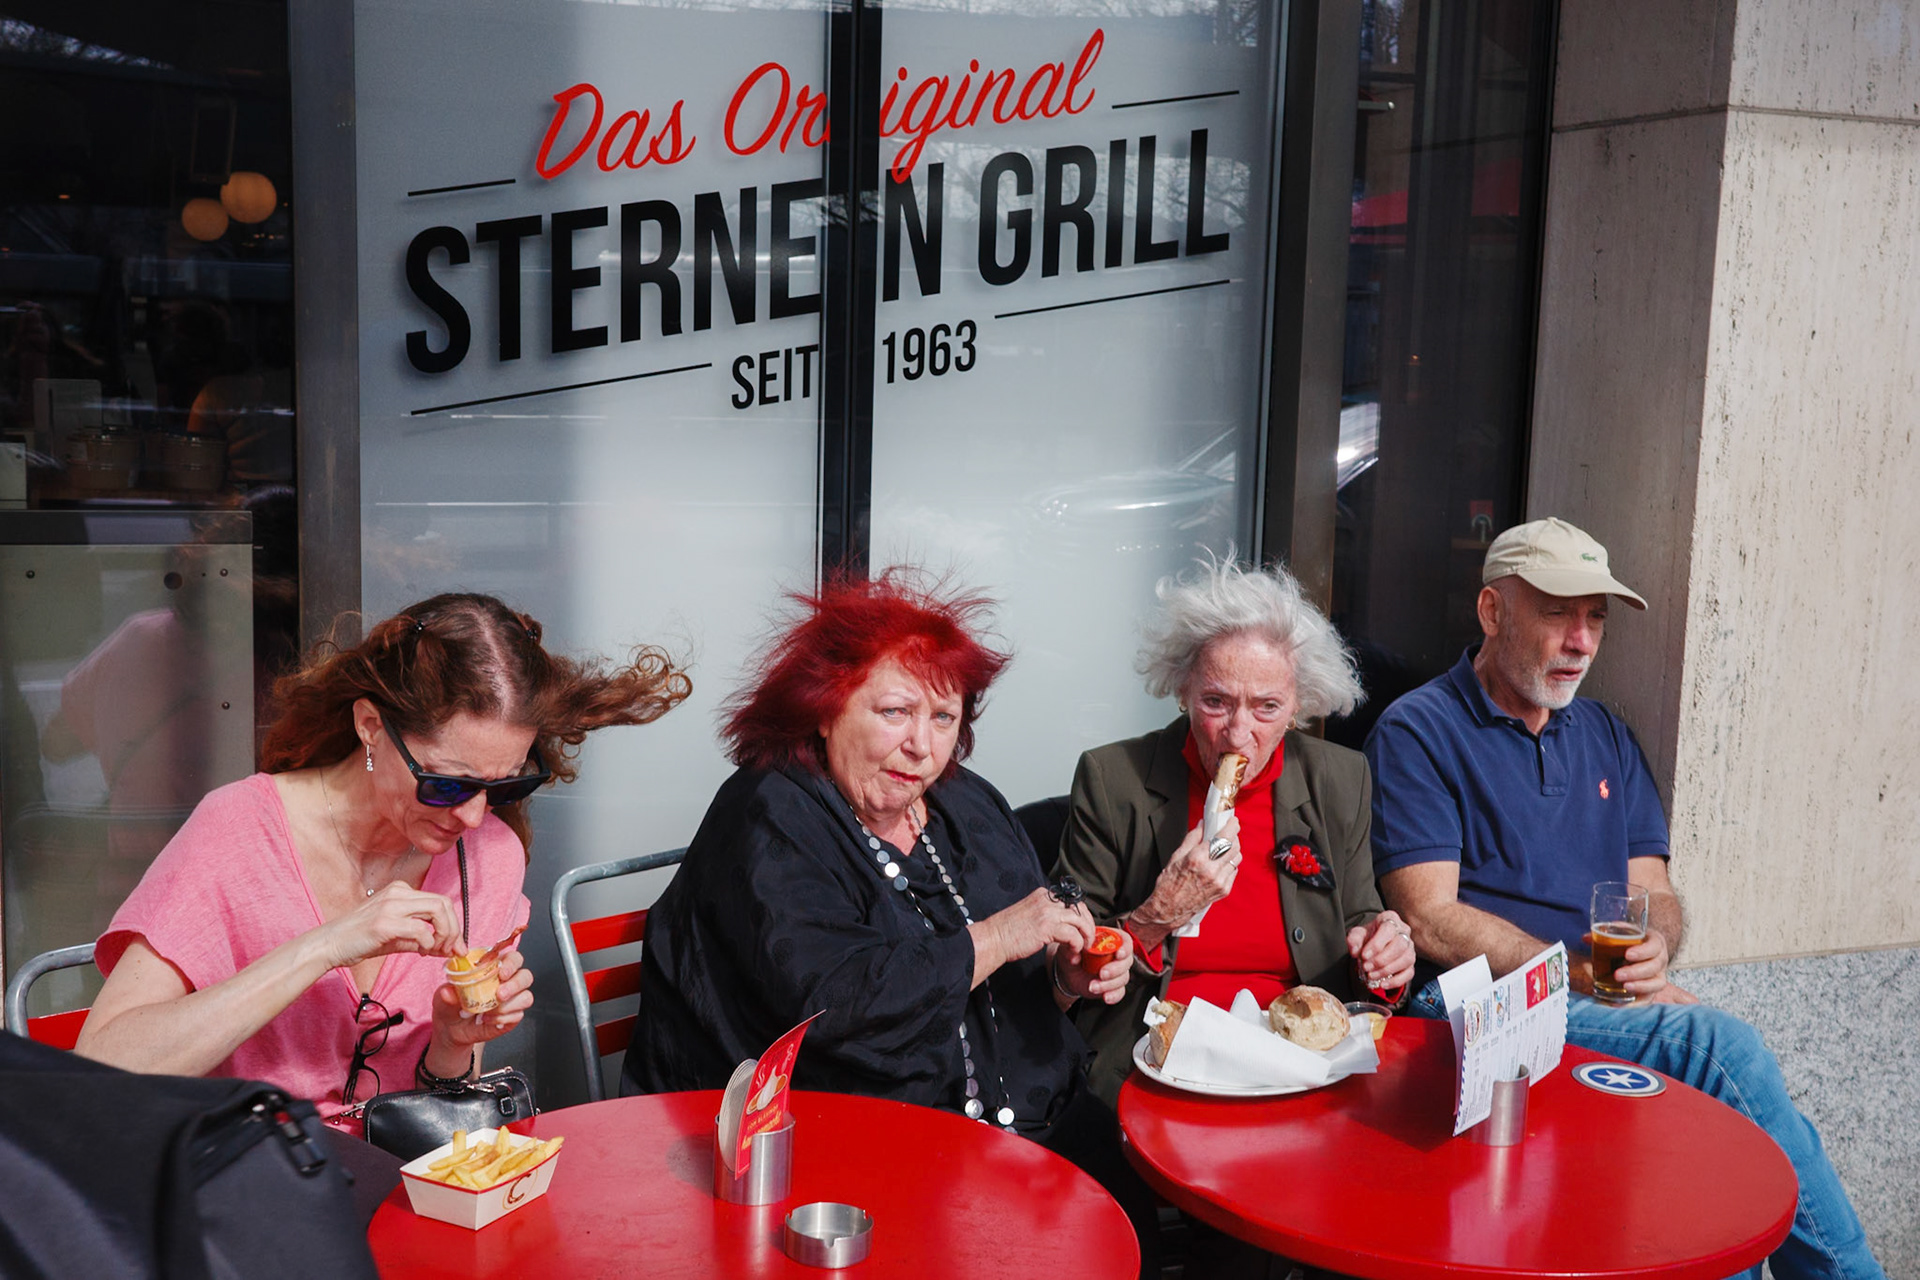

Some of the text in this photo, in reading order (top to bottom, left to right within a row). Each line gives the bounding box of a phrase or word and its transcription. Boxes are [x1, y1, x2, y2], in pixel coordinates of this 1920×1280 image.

[535, 28, 1105, 184] Das Original
[405, 128, 1230, 374] STERNEN GRILL
[731, 319, 977, 410] SEIT 1963
